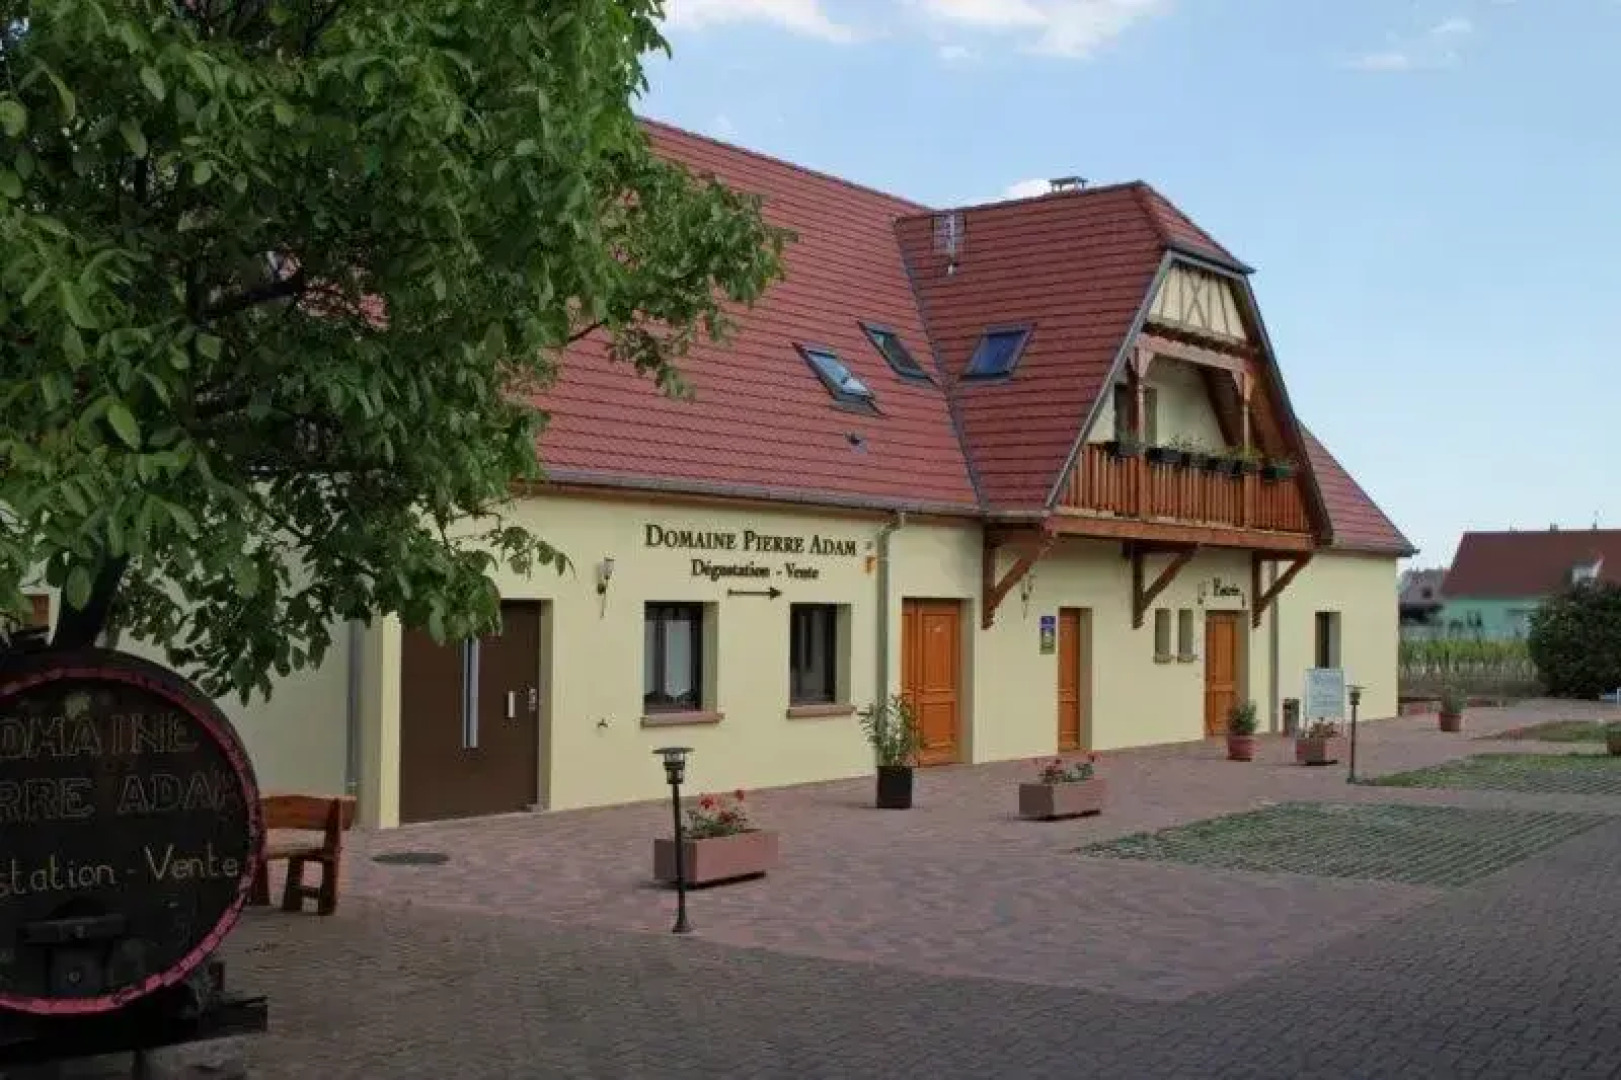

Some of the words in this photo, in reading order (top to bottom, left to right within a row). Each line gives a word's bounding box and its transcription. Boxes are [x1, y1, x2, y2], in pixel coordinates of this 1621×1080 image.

[645, 523, 737, 550] DOMAINE
[743, 530, 804, 553] PIERRE
[809, 534, 856, 556] ADAM
[691, 558, 770, 581] Dégustation
[785, 562, 820, 579] Vente
[144, 842, 239, 881] Vente
